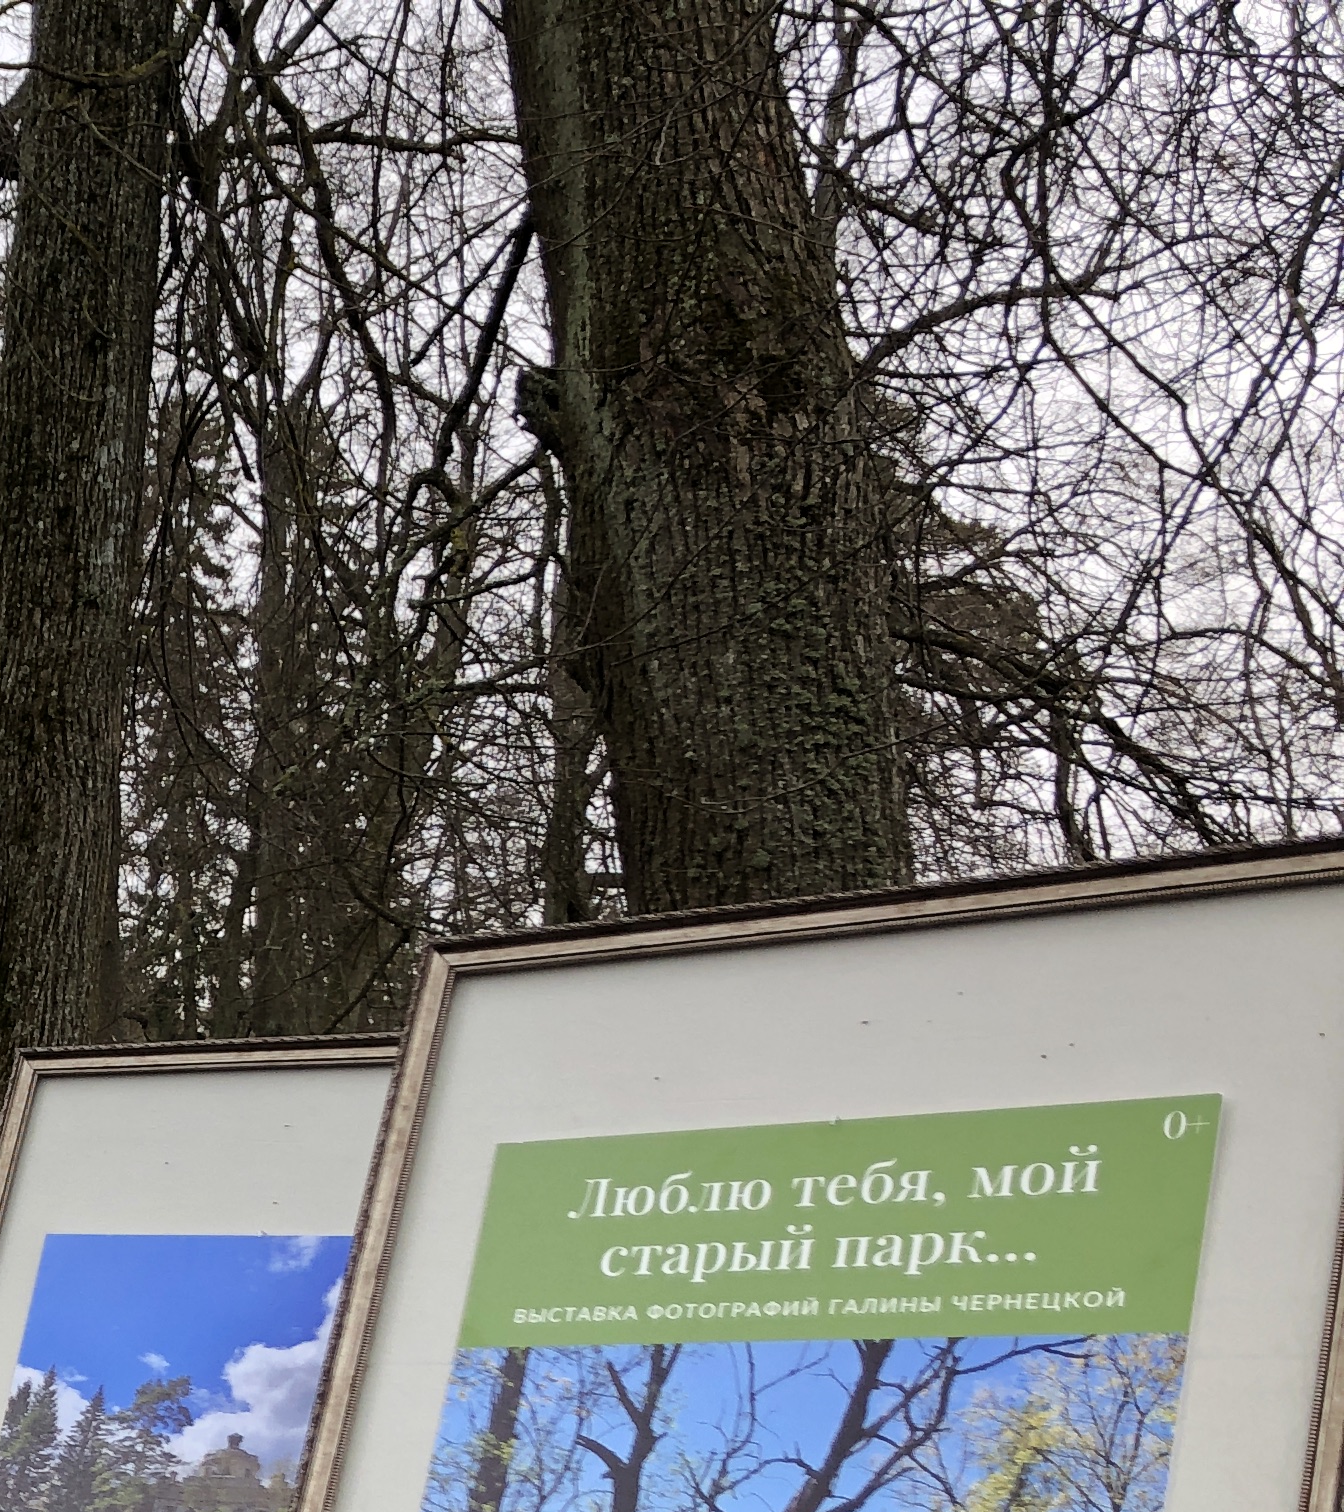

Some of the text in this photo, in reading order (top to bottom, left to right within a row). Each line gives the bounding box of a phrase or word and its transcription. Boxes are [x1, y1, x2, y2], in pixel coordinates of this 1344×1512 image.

[1162, 1110, 1211, 1140] 0+
[567, 1144, 1103, 1219] Люблю тебя, мой
[599, 1223, 1038, 1282] старый парк...
[513, 1287, 1126, 1324] ВЫСТАВКА ФОТОГРАФИЙ ГАЛИНЫ ЧЕРНЕЦКОЙ
